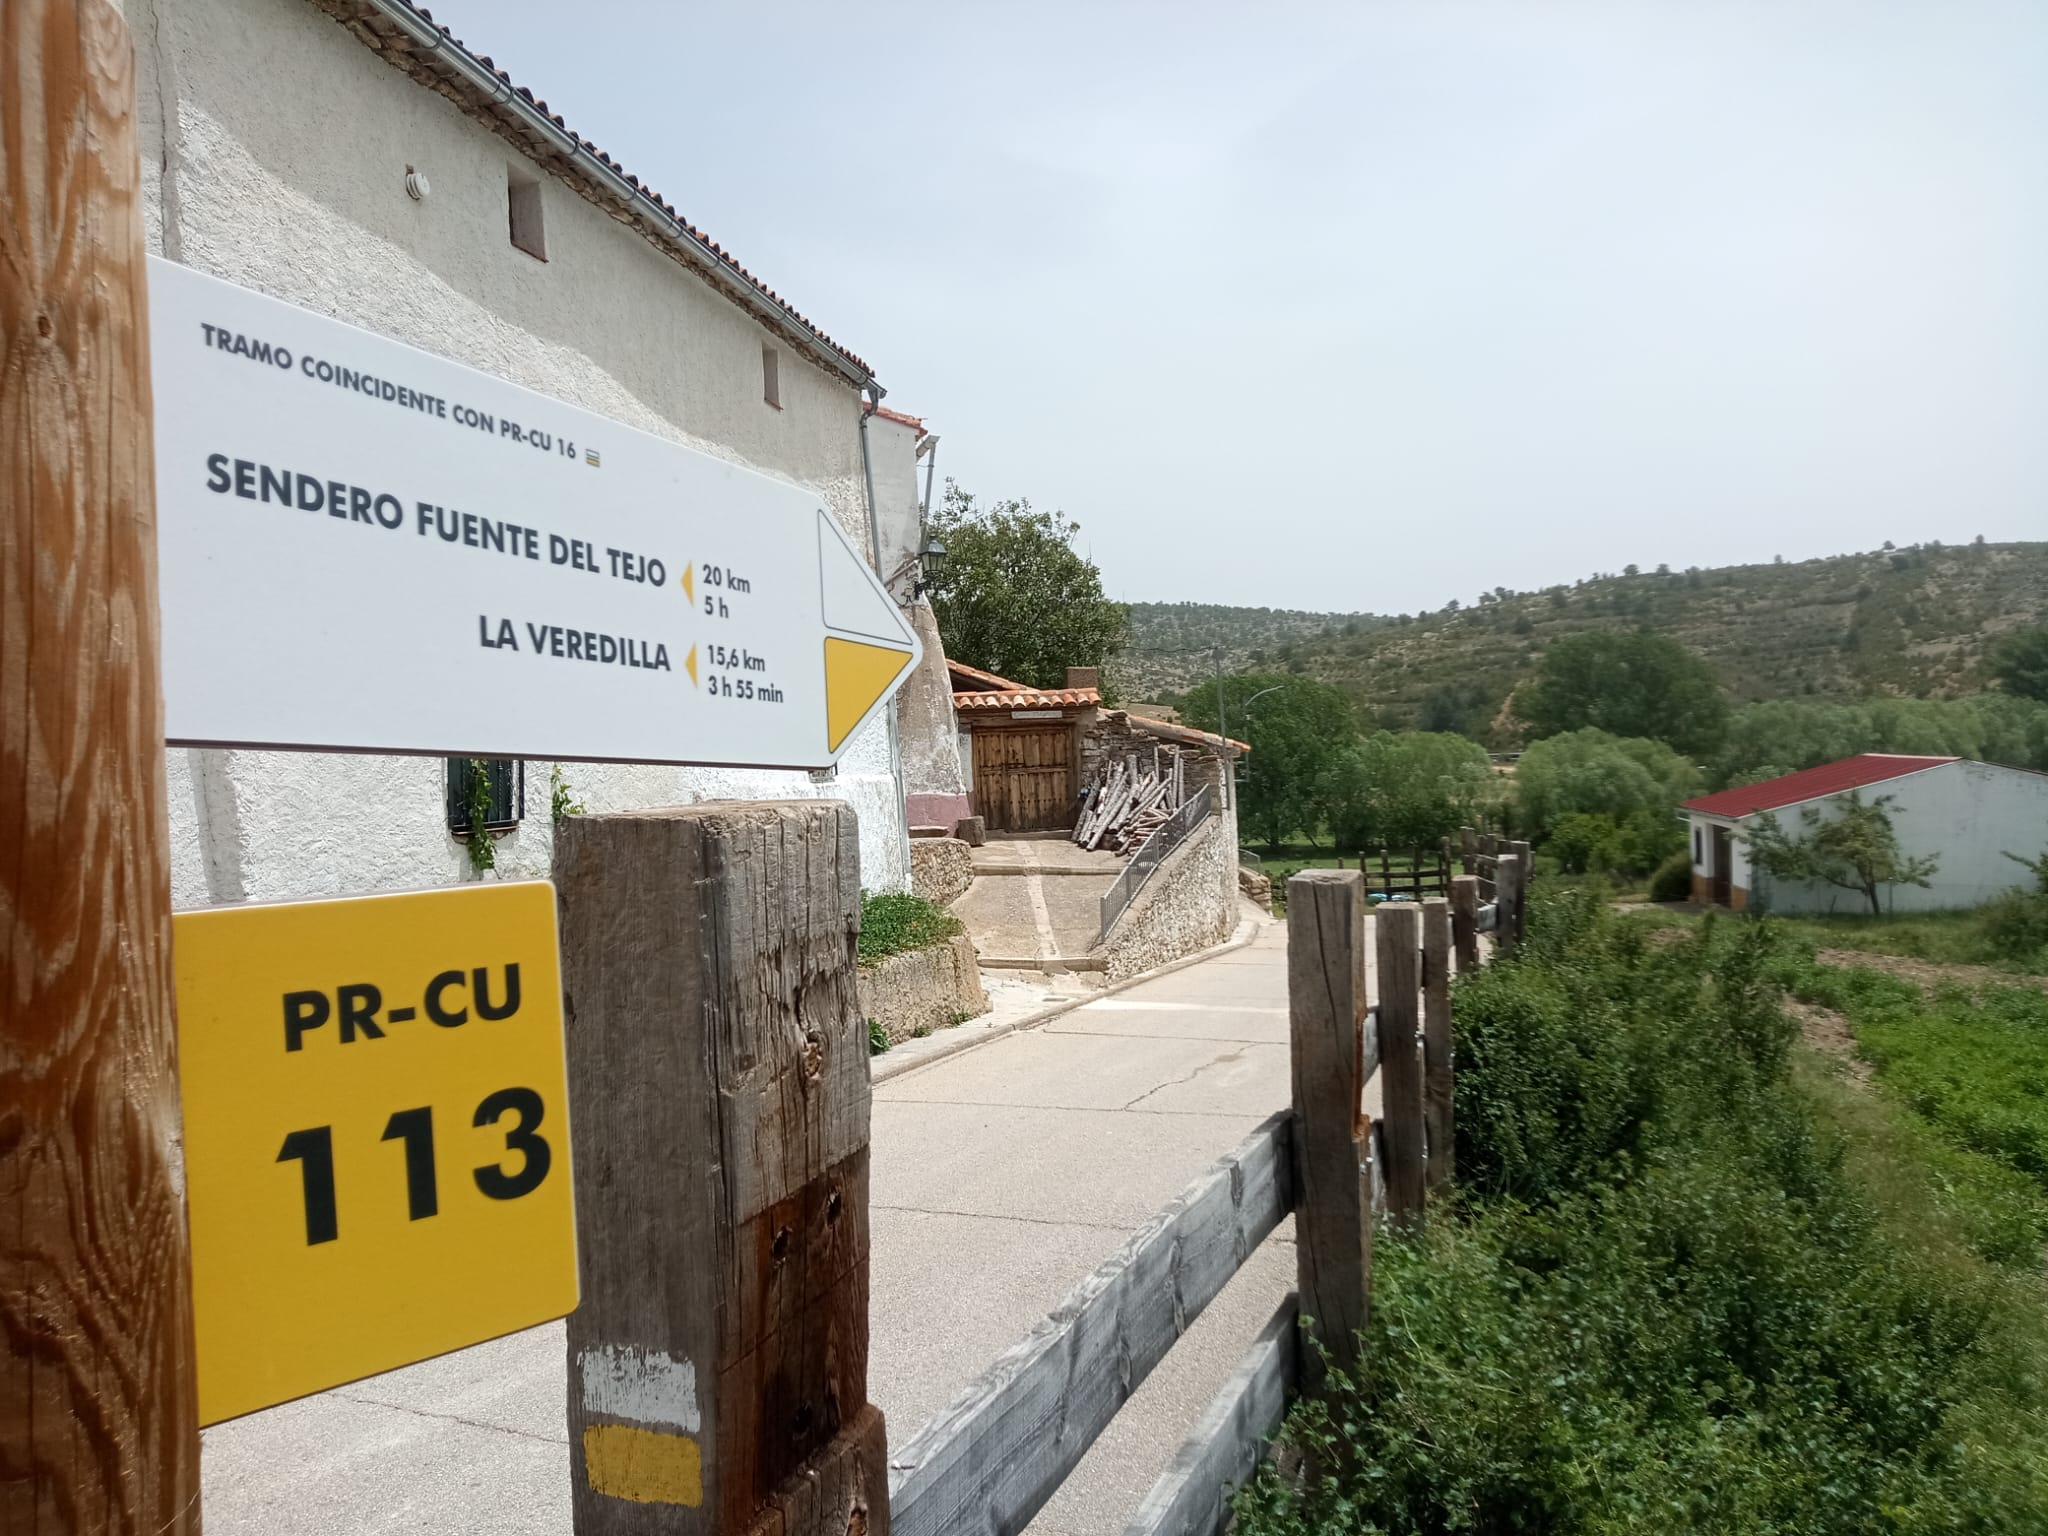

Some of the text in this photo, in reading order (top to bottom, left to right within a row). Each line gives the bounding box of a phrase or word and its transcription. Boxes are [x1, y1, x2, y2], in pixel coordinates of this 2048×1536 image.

[200, 321, 577, 460] TRAMO COINCIDENTE CON PR-CU 16
[205, 452, 667, 588] SENDERO FUENTE DEL TEJO
[702, 563, 751, 594] 20 km
[703, 594, 730, 619] 5 h
[479, 614, 672, 673] LA VEREDILLA
[707, 643, 766, 673] 15,6 km
[707, 674, 785, 704] 3 h 55 min
[281, 961, 522, 1054] PR-CU
[274, 1085, 553, 1248] 113
